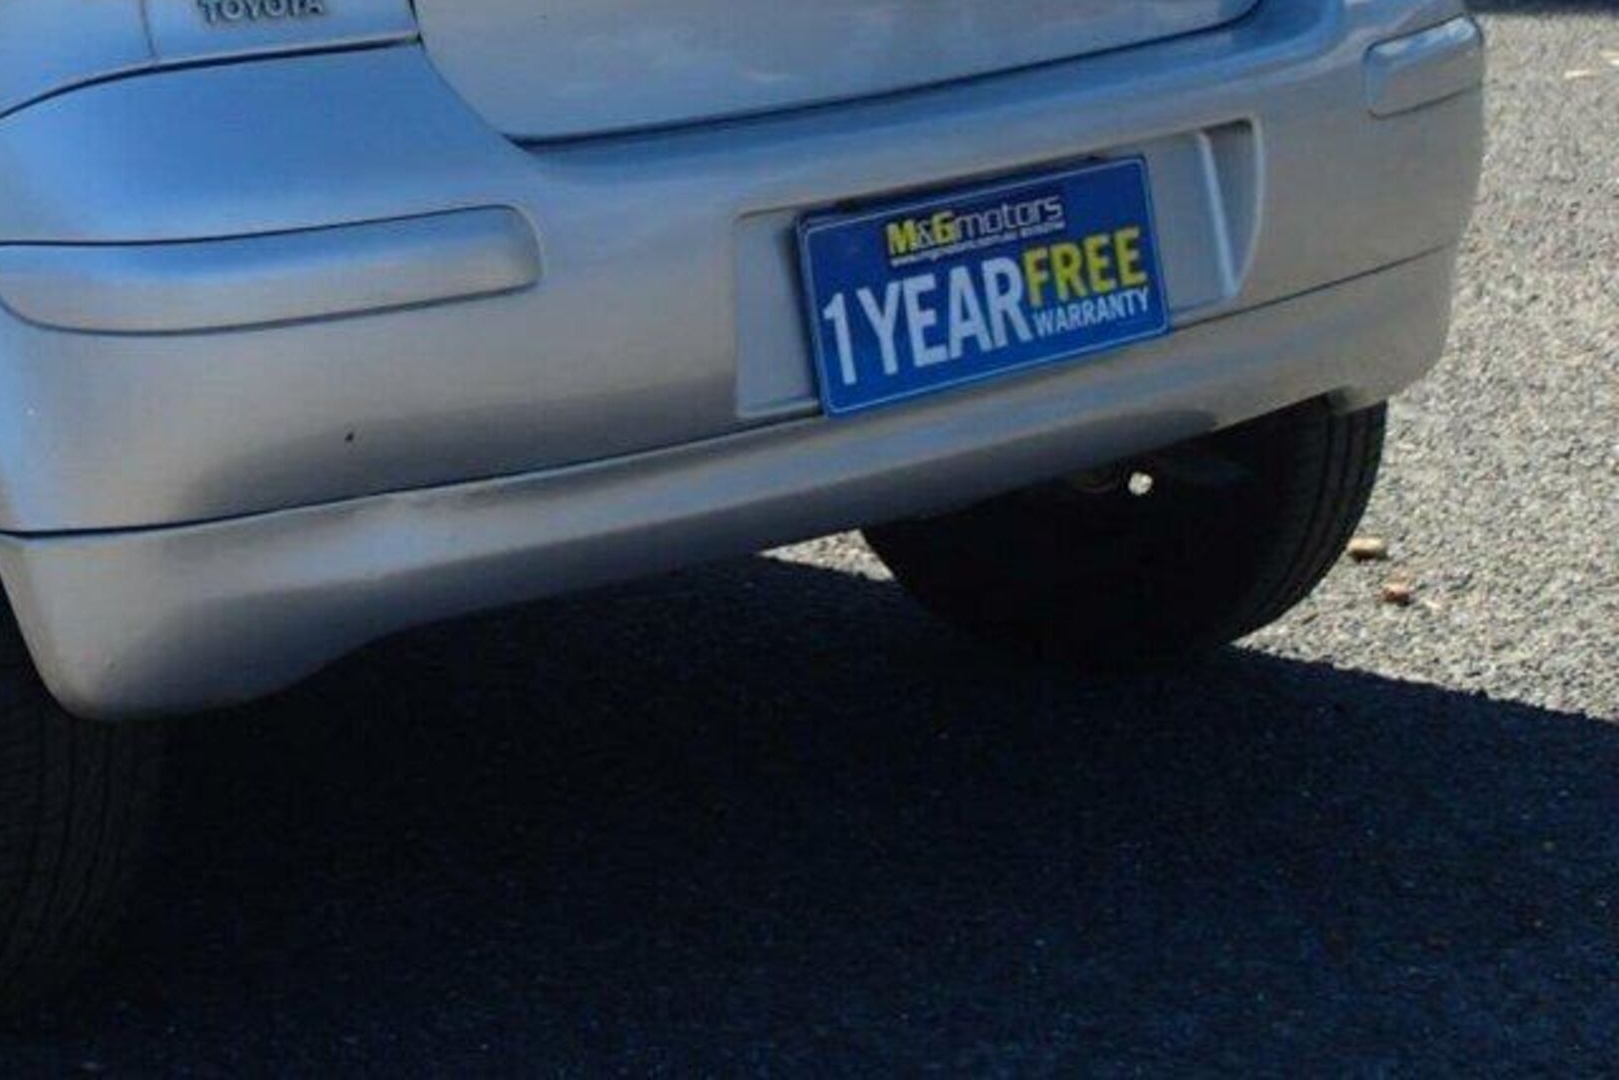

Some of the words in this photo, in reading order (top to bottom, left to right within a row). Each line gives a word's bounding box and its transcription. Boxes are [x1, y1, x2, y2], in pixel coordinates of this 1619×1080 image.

[823, 292, 856, 385] 1
[856, 257, 1034, 376] YEAR
[1022, 226, 1148, 307] FREE
[1033, 286, 1150, 338] WARRANTY
